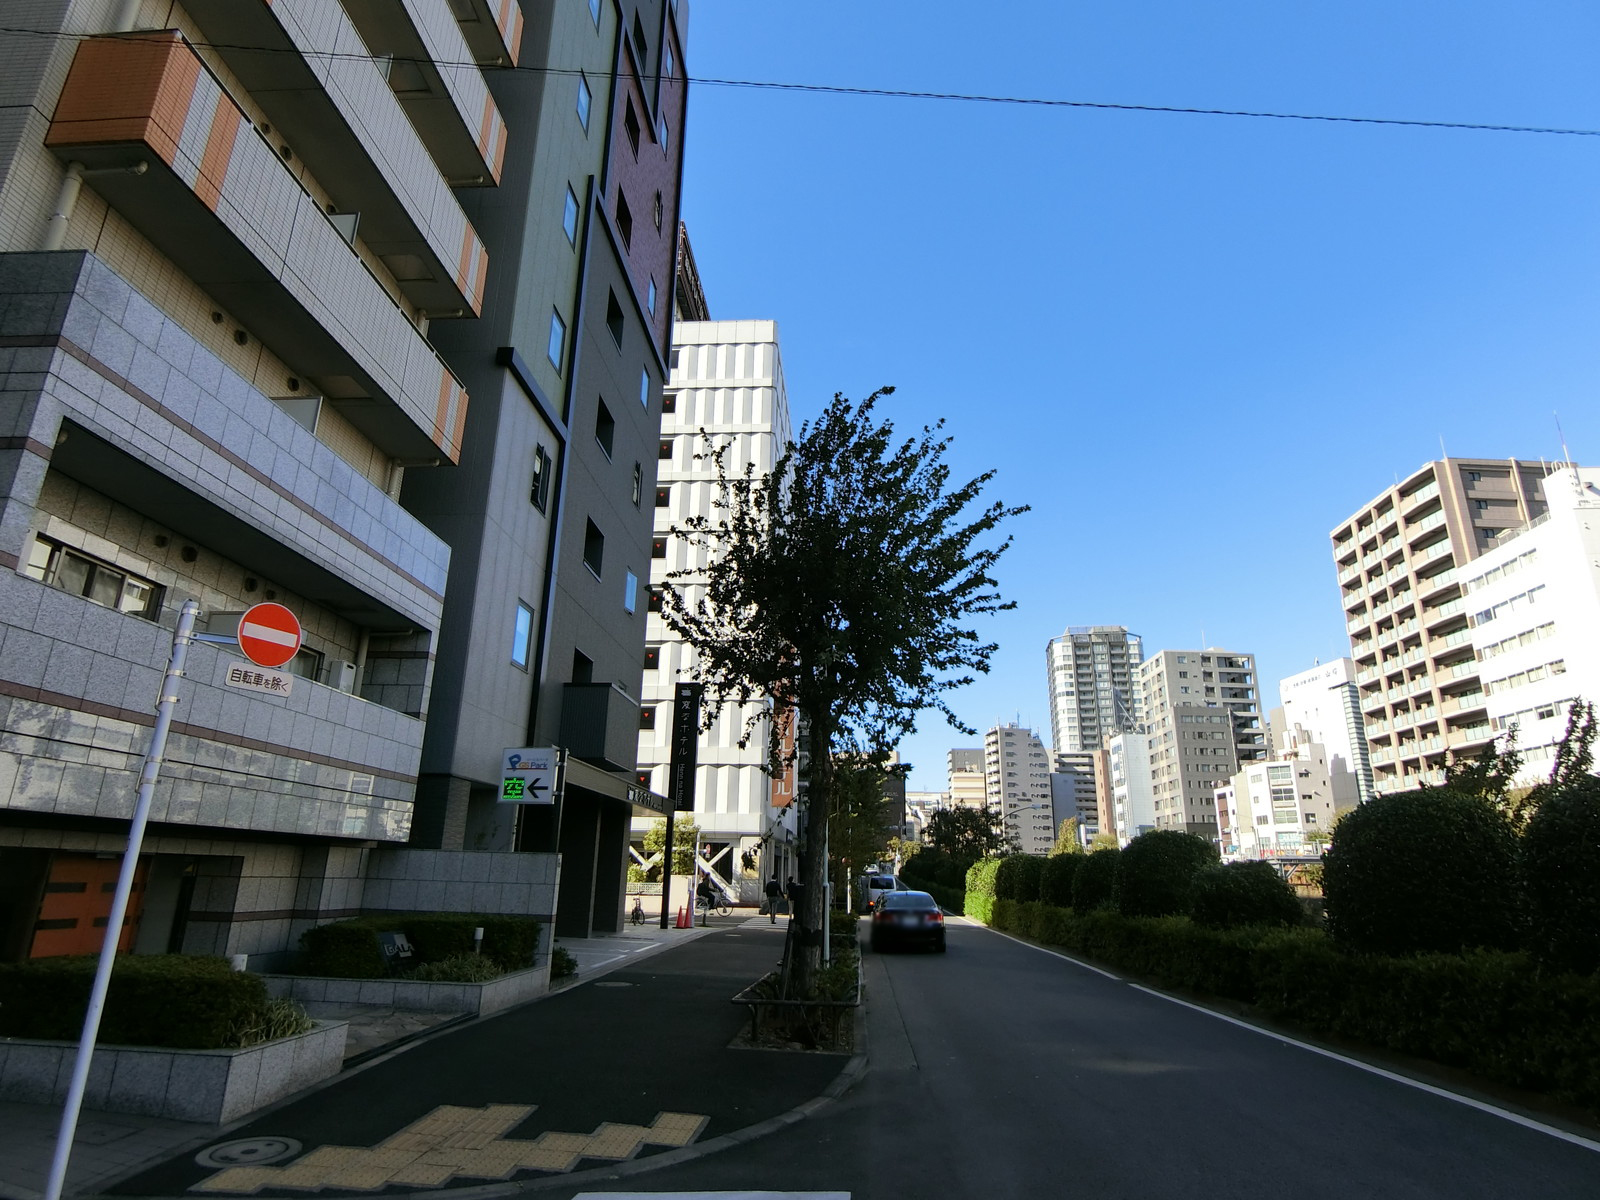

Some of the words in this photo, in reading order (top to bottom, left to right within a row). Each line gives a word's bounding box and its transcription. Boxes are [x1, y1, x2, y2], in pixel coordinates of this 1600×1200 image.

[230, 668, 289, 692] 自転車を除く
[679, 700, 691, 756] 変なホテル
